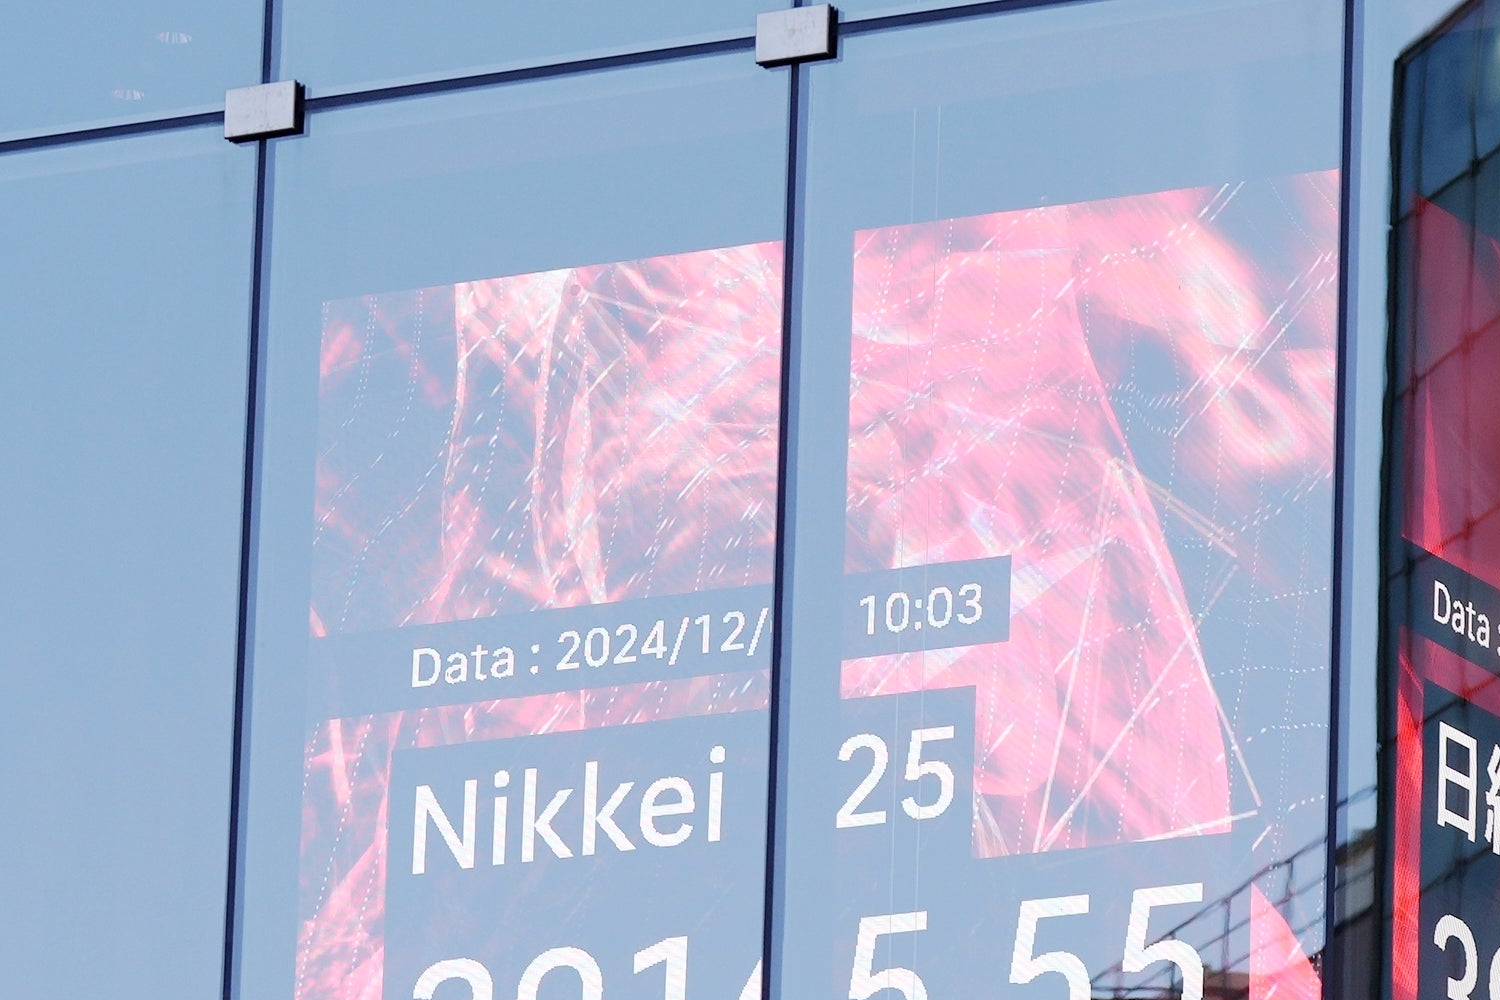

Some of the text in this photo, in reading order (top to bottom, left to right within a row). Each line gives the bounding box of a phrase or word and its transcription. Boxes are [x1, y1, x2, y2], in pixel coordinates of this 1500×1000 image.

[556, 607, 772, 671] 2024/12/
[859, 583, 984, 636] 10:03
[411, 725, 956, 875] Nikkei 25
